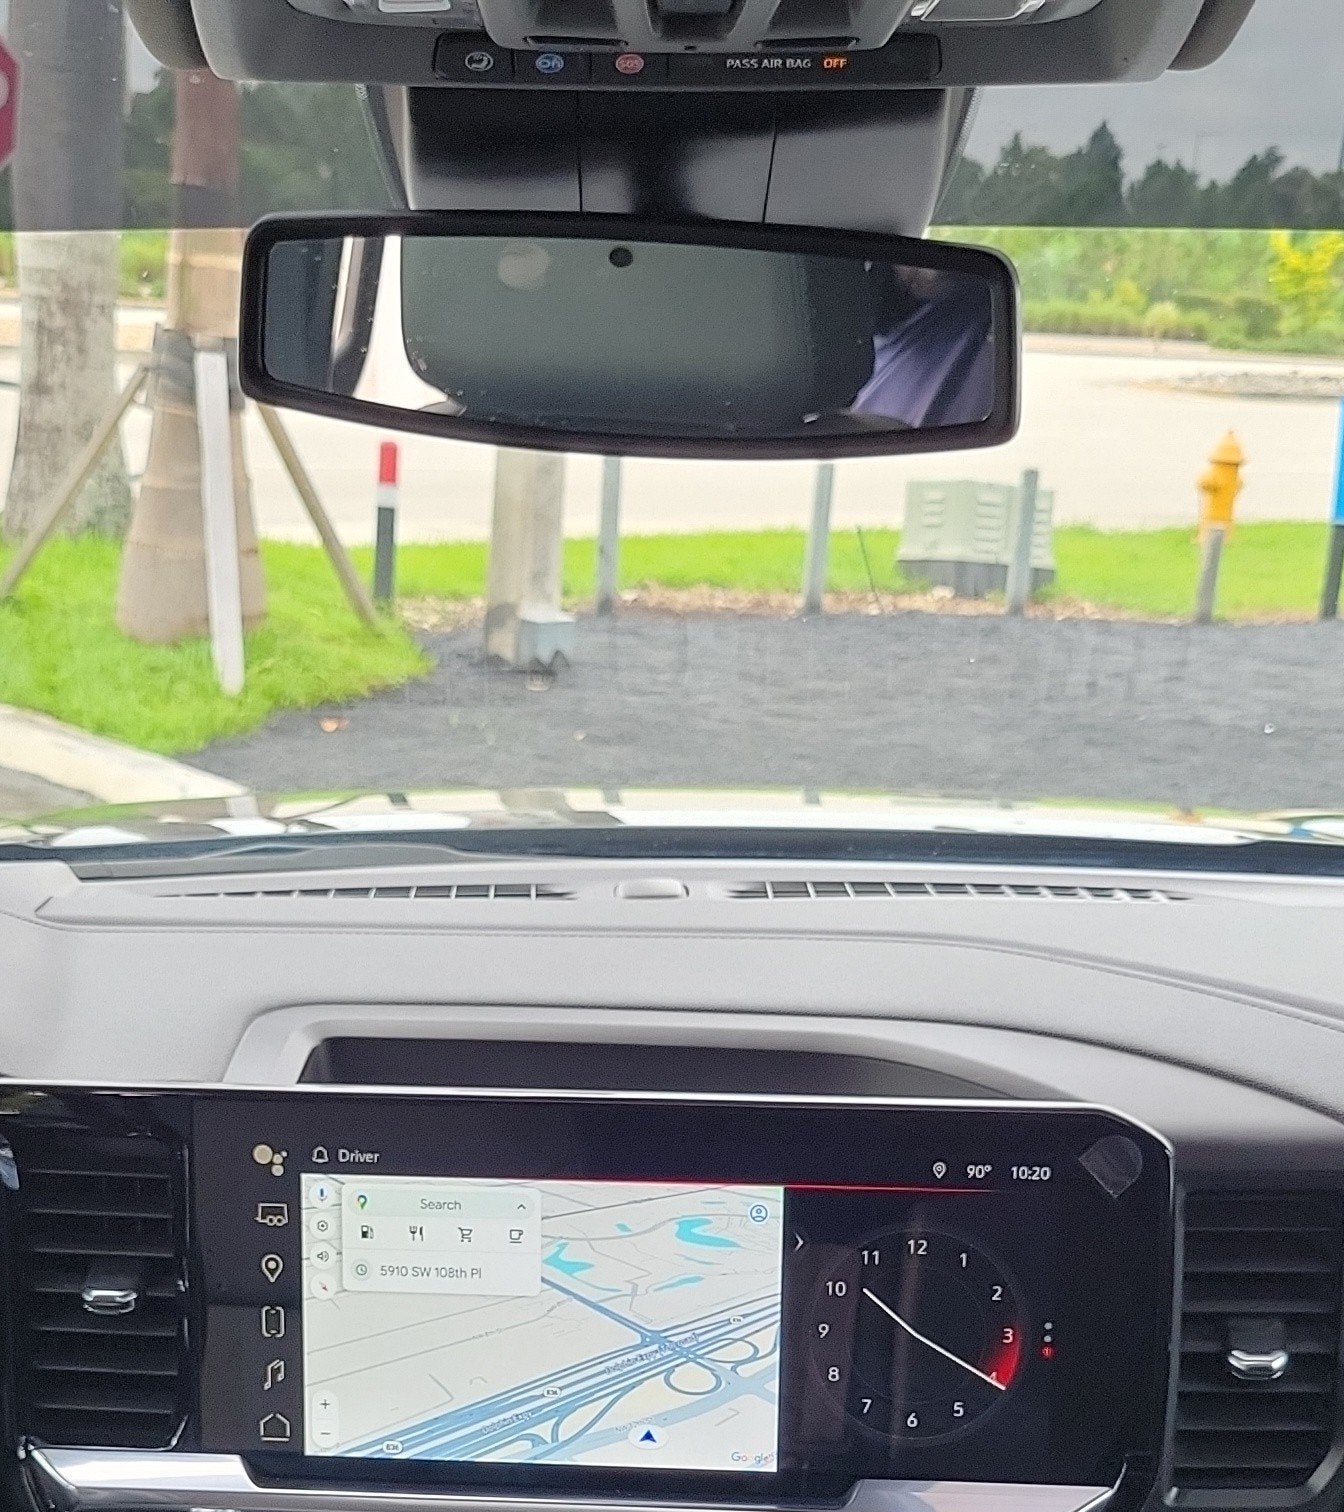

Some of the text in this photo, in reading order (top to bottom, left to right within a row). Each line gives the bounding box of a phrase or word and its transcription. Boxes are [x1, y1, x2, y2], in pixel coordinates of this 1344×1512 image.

[726, 58, 848, 69] PASS AIR BAG OFF
[337, 1149, 380, 1164] Driver
[966, 1164, 1052, 1181] 90° 10:20
[420, 1198, 462, 1212] Search
[907, 1239, 928, 1255] 12
[861, 1250, 881, 1266] 11
[959, 1253, 969, 1268] 1
[380, 1265, 409, 1277] 5910
[411, 1265, 432, 1278] SW
[435, 1266, 467, 1279] 108th
[825, 1280, 847, 1297] 10
[991, 1286, 1003, 1301] 2
[818, 1323, 830, 1339] 9
[1002, 1328, 1014, 1344] 3
[827, 1366, 840, 1382] 8
[861, 1398, 872, 1414] 7
[953, 1402, 965, 1418] 5
[906, 1412, 918, 1428] 6
